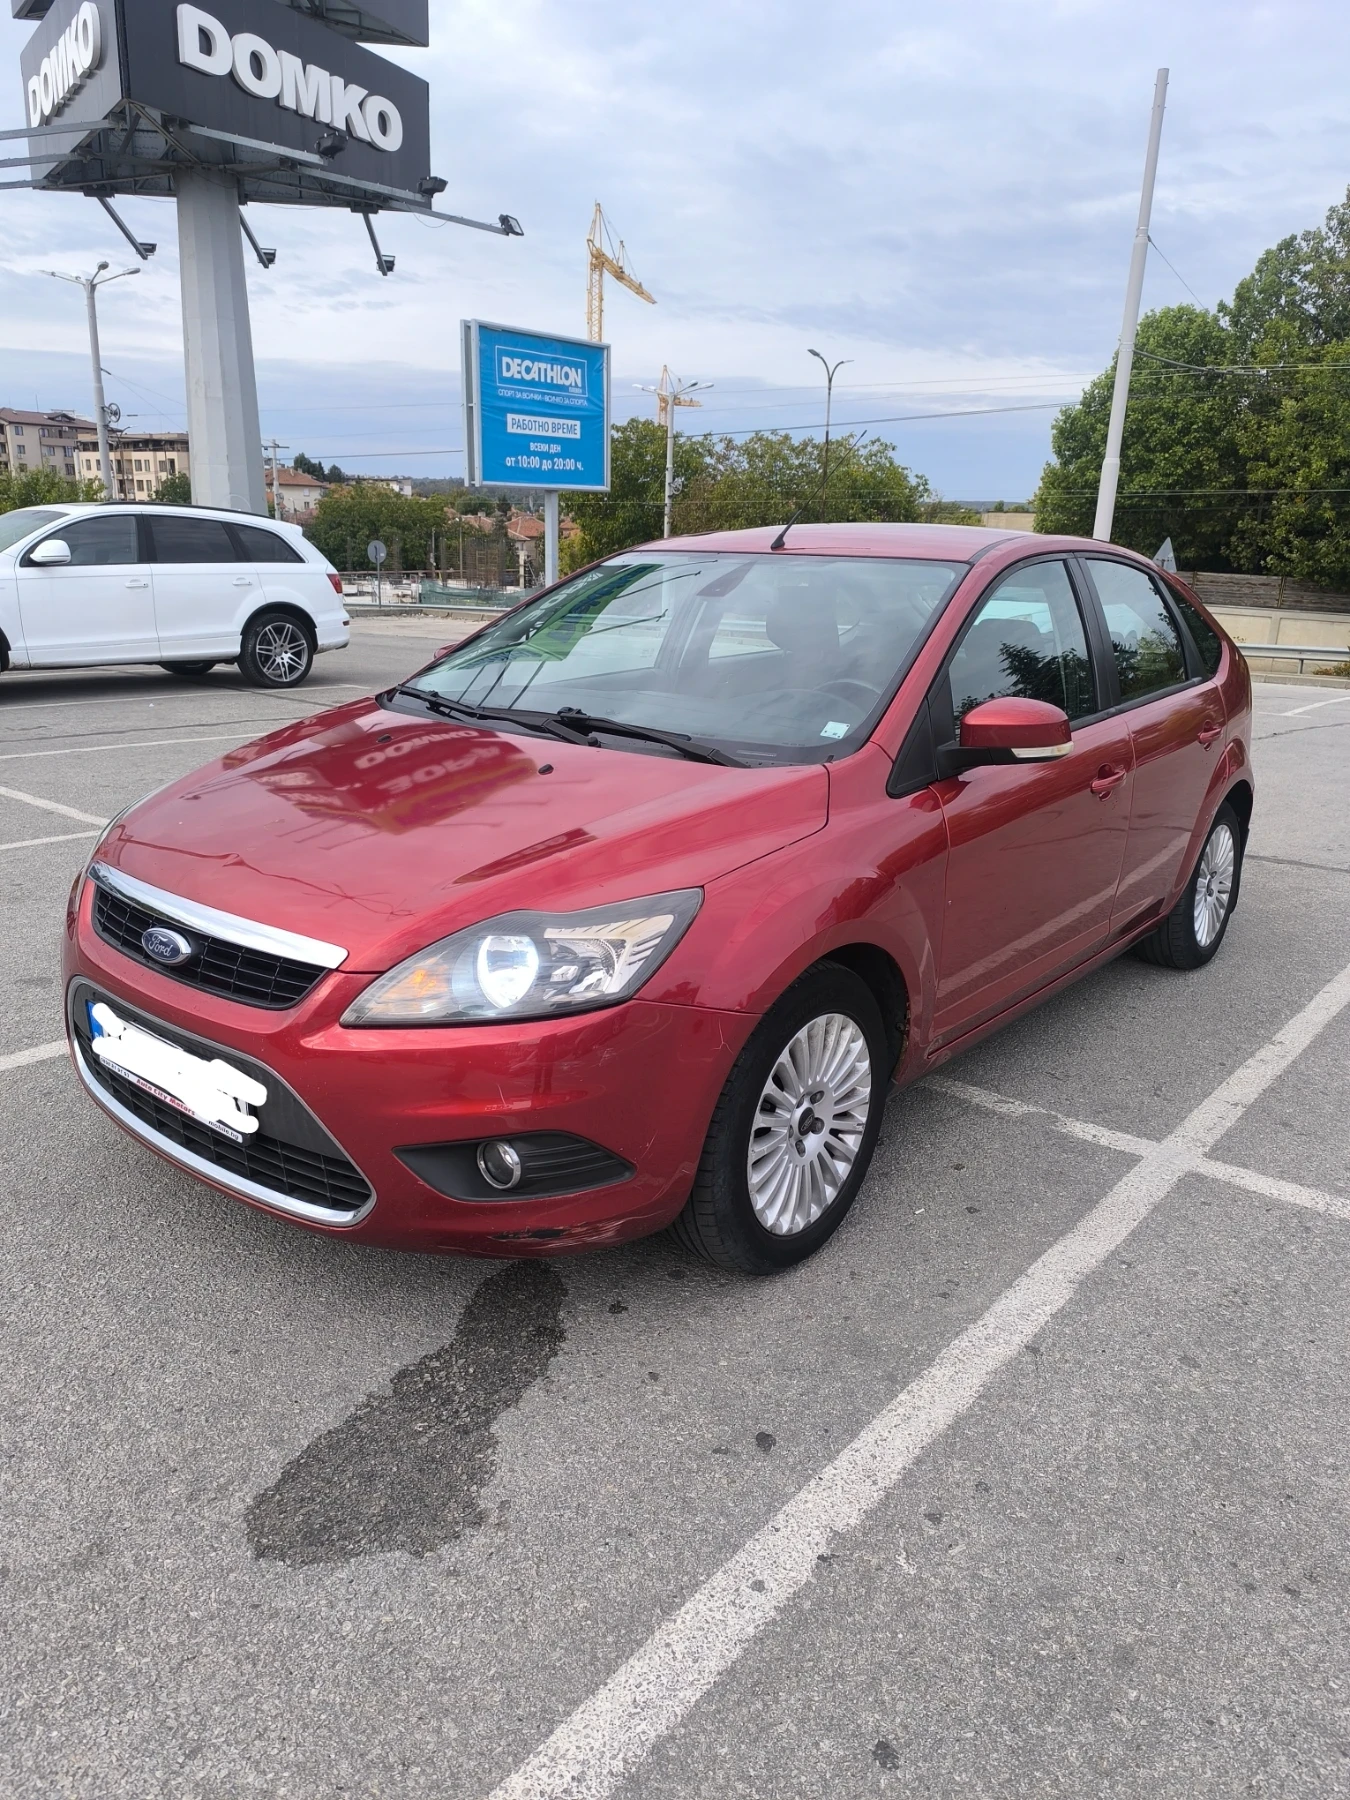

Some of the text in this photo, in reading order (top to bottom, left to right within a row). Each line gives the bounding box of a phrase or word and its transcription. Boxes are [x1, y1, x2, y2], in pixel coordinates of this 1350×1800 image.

[28, 1, 101, 128] DOMKO
[176, 3, 403, 152] DOMKO
[501, 356, 582, 387] DECATHLON
[498, 388, 514, 398] СПОРТ
[515, 391, 521, 399] ЗА
[511, 417, 578, 436] РАБОТНО ВРЕМЕ
[529, 442, 561, 454] ВСЕКИ ДЕН
[506, 455, 584, 471] от 10:00 до 20:00 ч.
[148, 933, 174, 957] Ford
[136, 1079, 195, 1116] Auto City Motors
[208, 1120, 240, 1141] mobile.bg
